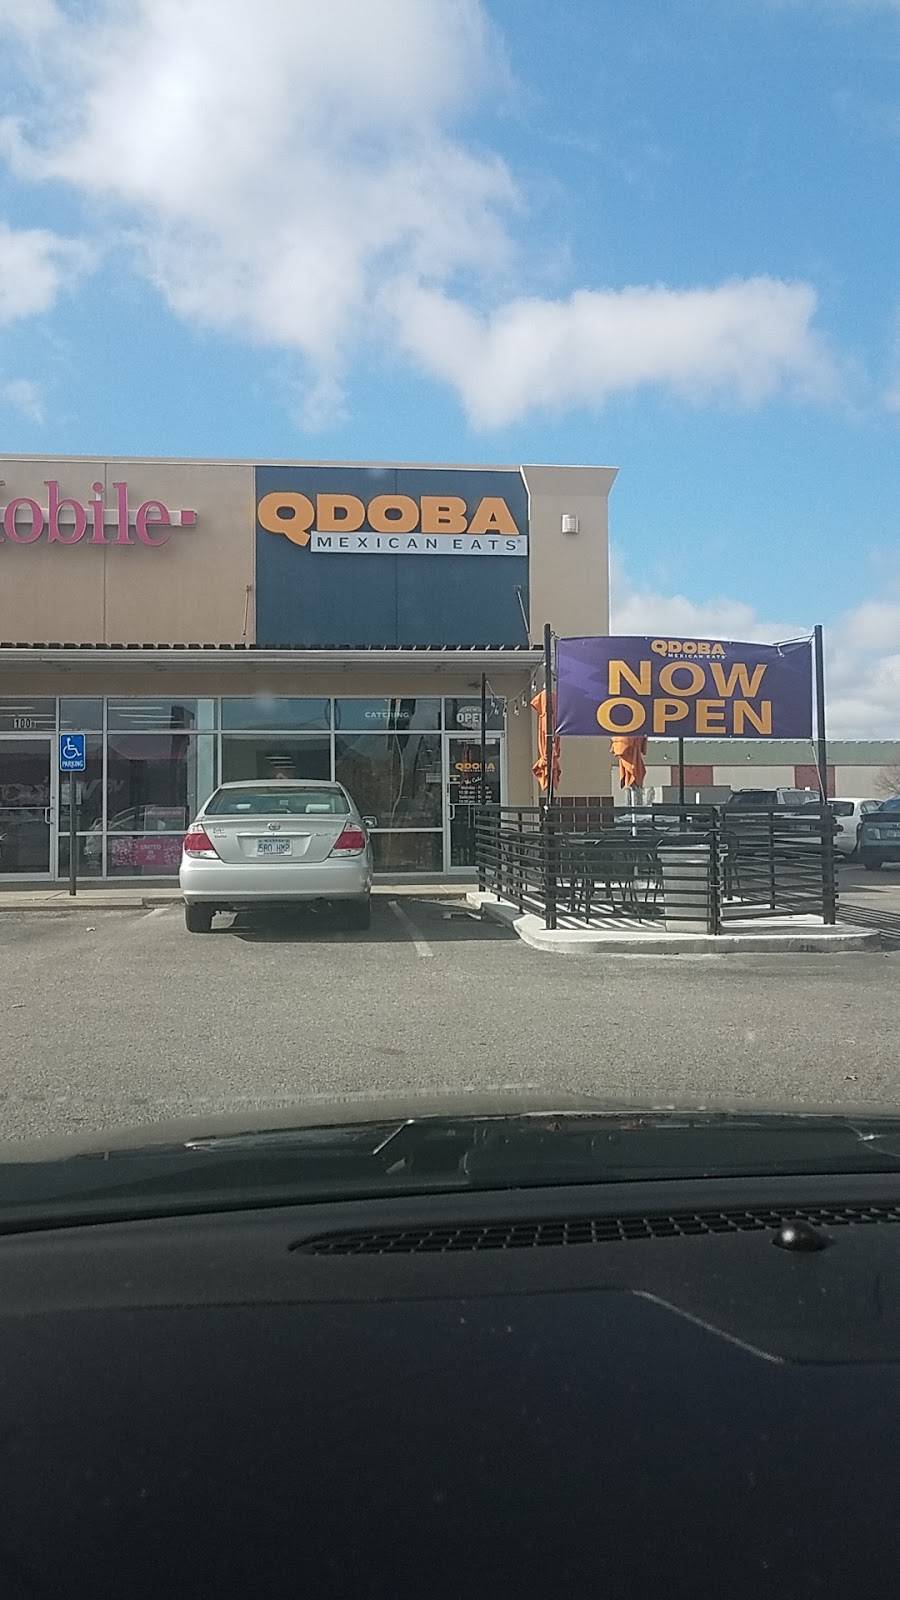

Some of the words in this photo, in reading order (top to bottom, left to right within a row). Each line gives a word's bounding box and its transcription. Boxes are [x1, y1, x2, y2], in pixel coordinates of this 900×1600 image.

[0, 481, 171, 546] obile
[257, 491, 520, 546] QDOBA
[316, 537, 438, 550] MEXICAN
[651, 639, 726, 657] QDOBA
[608, 659, 768, 698] NOW
[596, 697, 773, 735] OPEN
[62, 760, 84, 768] PARKING
